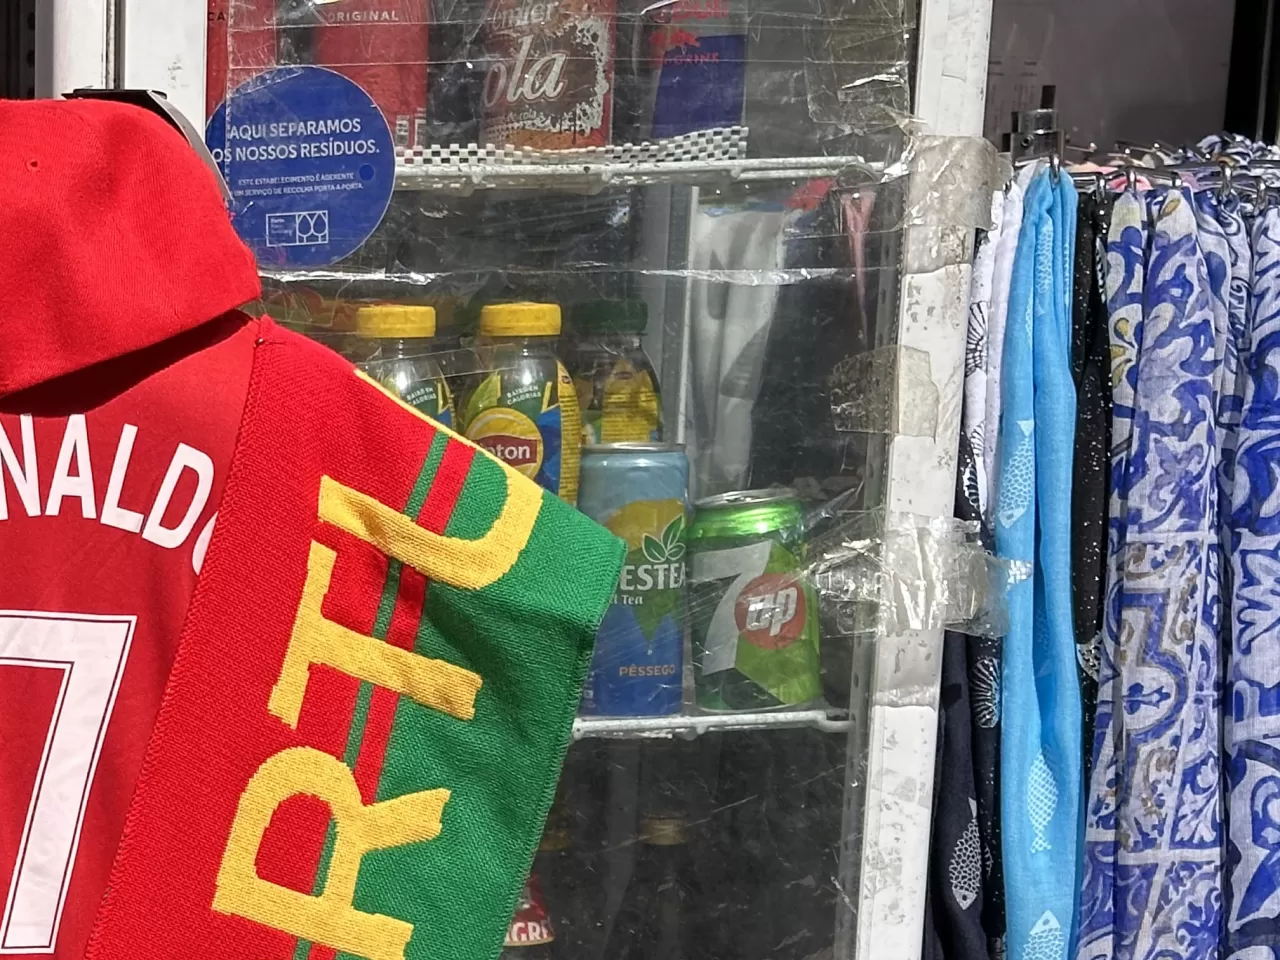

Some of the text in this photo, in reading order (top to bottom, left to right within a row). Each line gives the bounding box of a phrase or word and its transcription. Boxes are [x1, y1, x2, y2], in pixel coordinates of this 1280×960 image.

[327, 10, 400, 22] ORIGINAL
[229, 118, 361, 141] AQUI SEPARAMOS
[212, 137, 380, 163] OS NOSSOS RESÍDUOS.
[621, 594, 644, 606] Tea
[619, 664, 676, 677] PÊSSEGO
